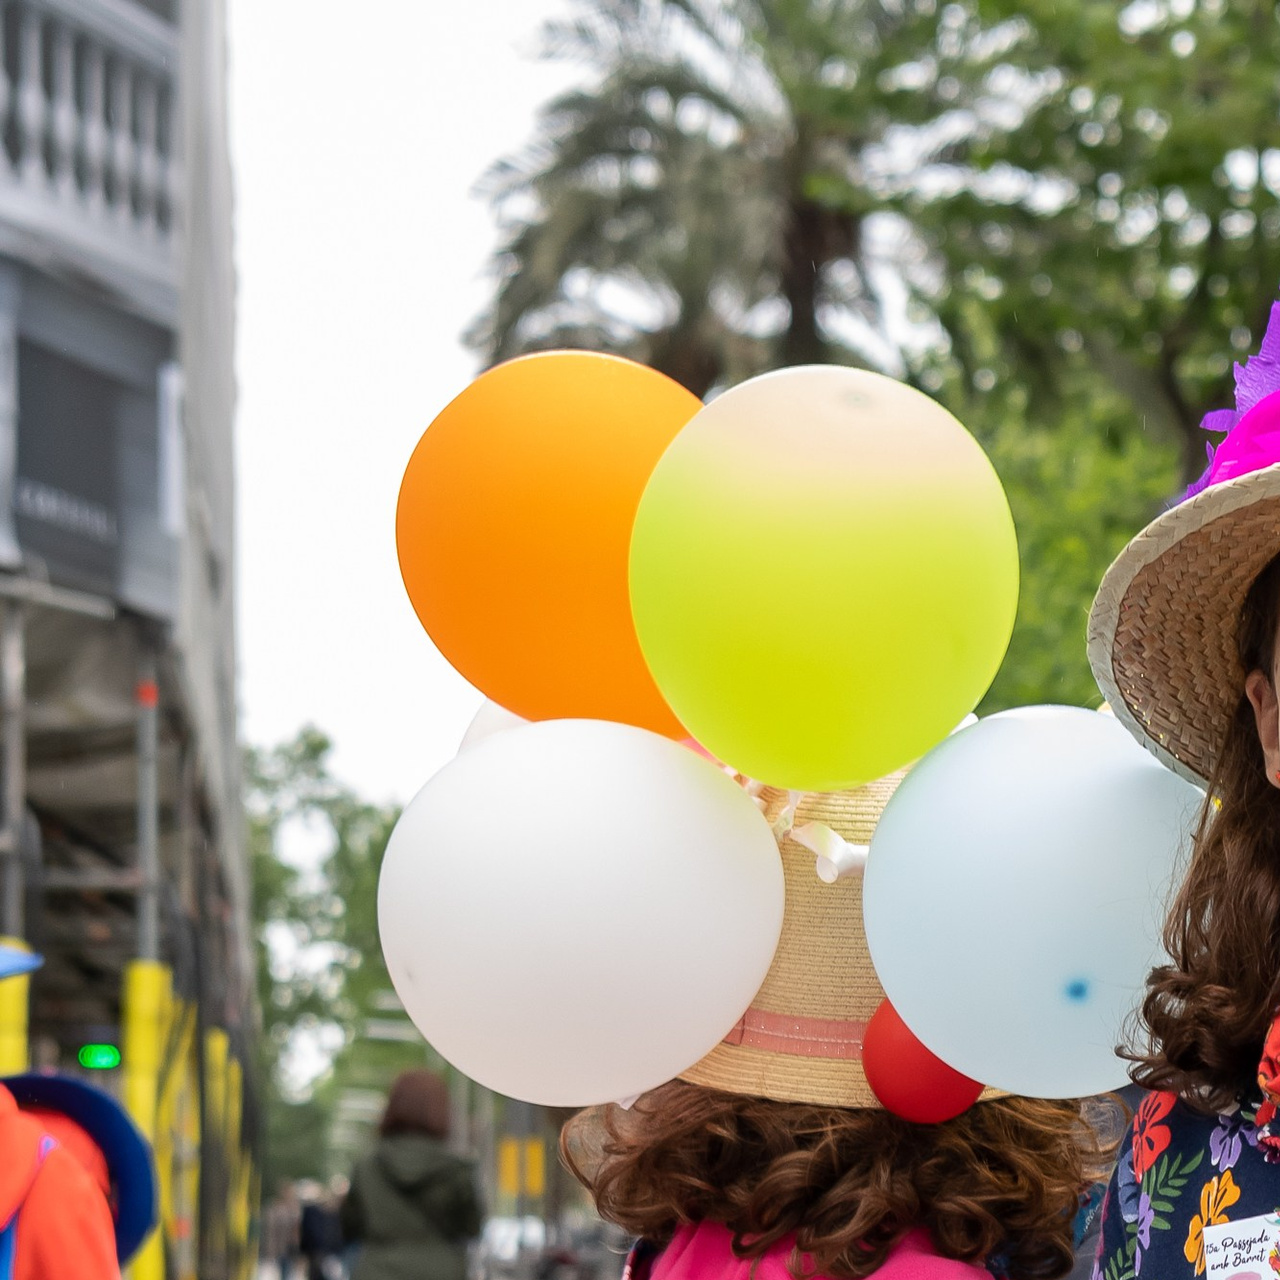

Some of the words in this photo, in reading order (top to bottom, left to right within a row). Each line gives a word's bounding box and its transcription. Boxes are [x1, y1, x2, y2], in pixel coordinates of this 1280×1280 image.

[1205, 1243, 1220, 1254] 15a
[1221, 1229, 1271, 1254] Passejada
[1210, 1254, 1229, 1271] amb
[1231, 1247, 1267, 1268] Barret
